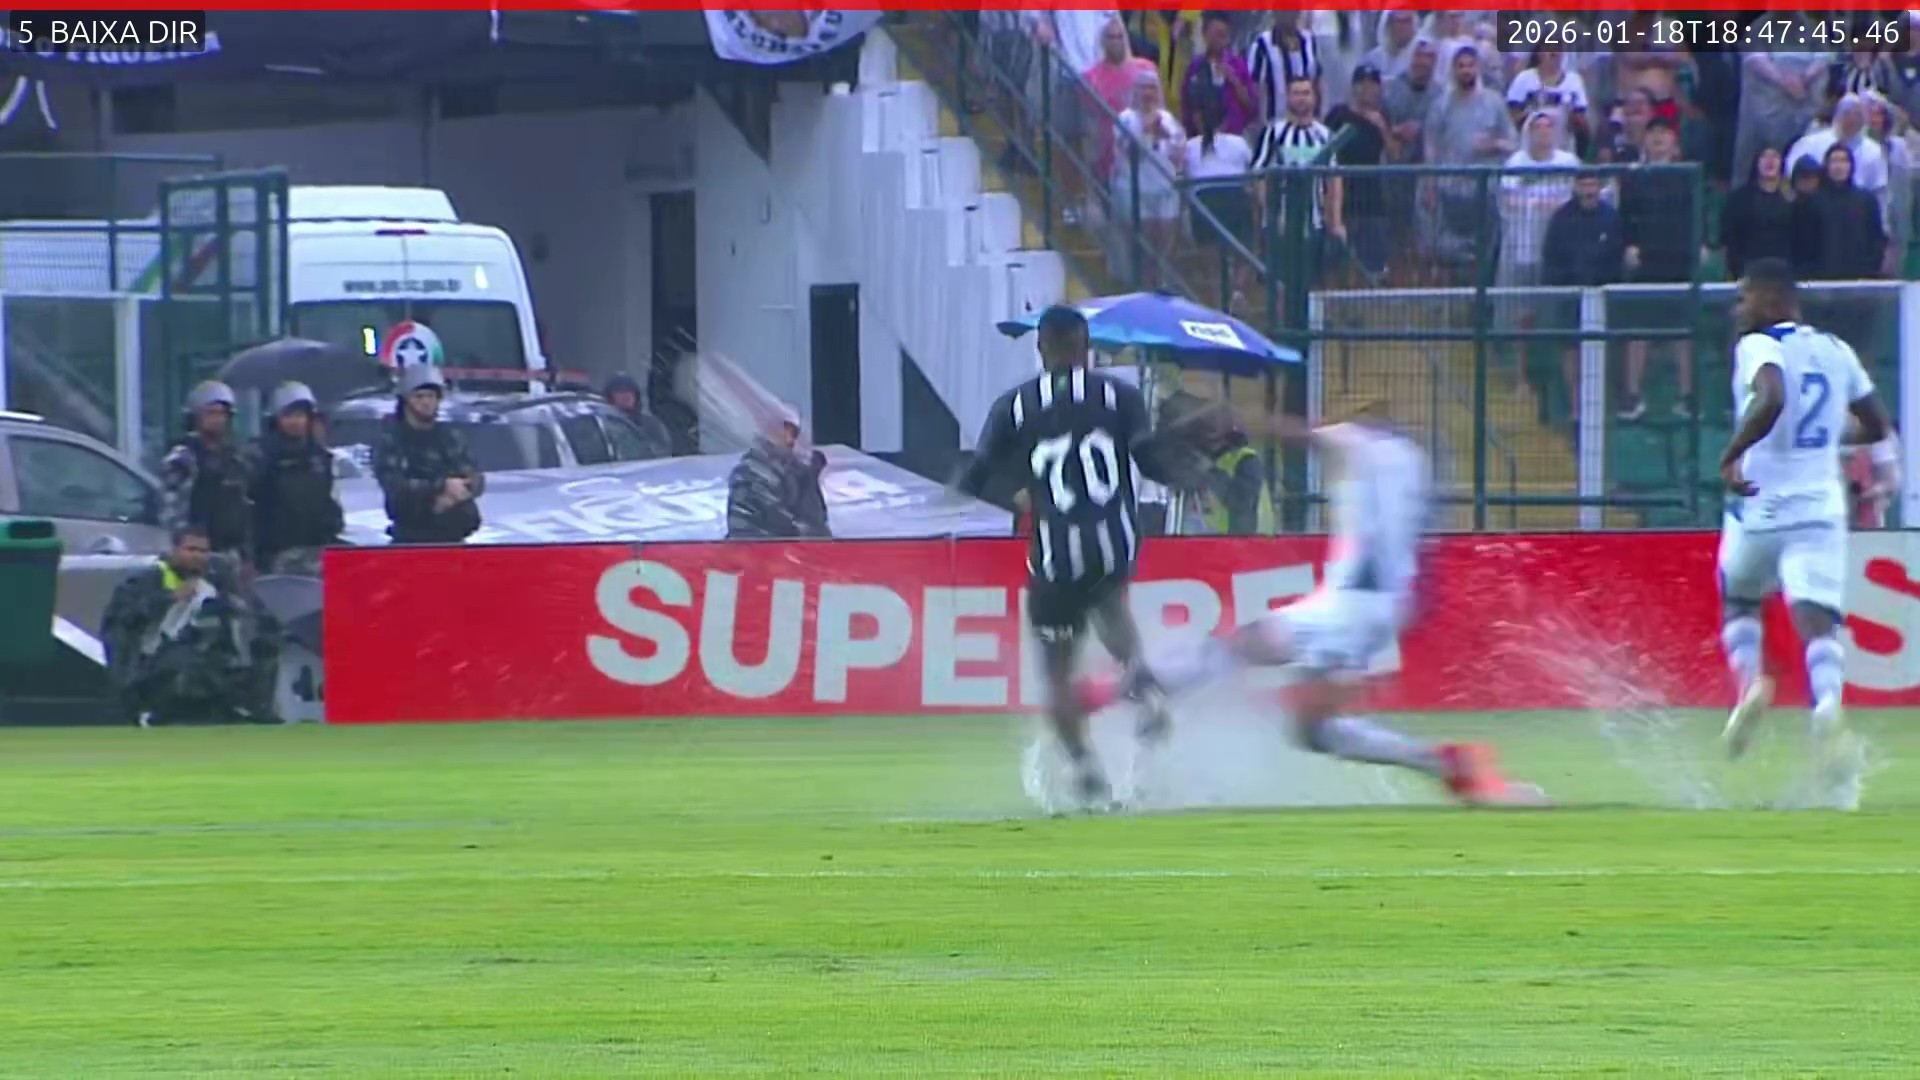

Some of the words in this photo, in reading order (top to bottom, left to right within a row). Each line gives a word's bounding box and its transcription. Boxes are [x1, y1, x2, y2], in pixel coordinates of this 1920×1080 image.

[1793, 372, 1829, 449] 2
[1030, 428, 1119, 513] 70
[585, 559, 1401, 707] SUPEBE
